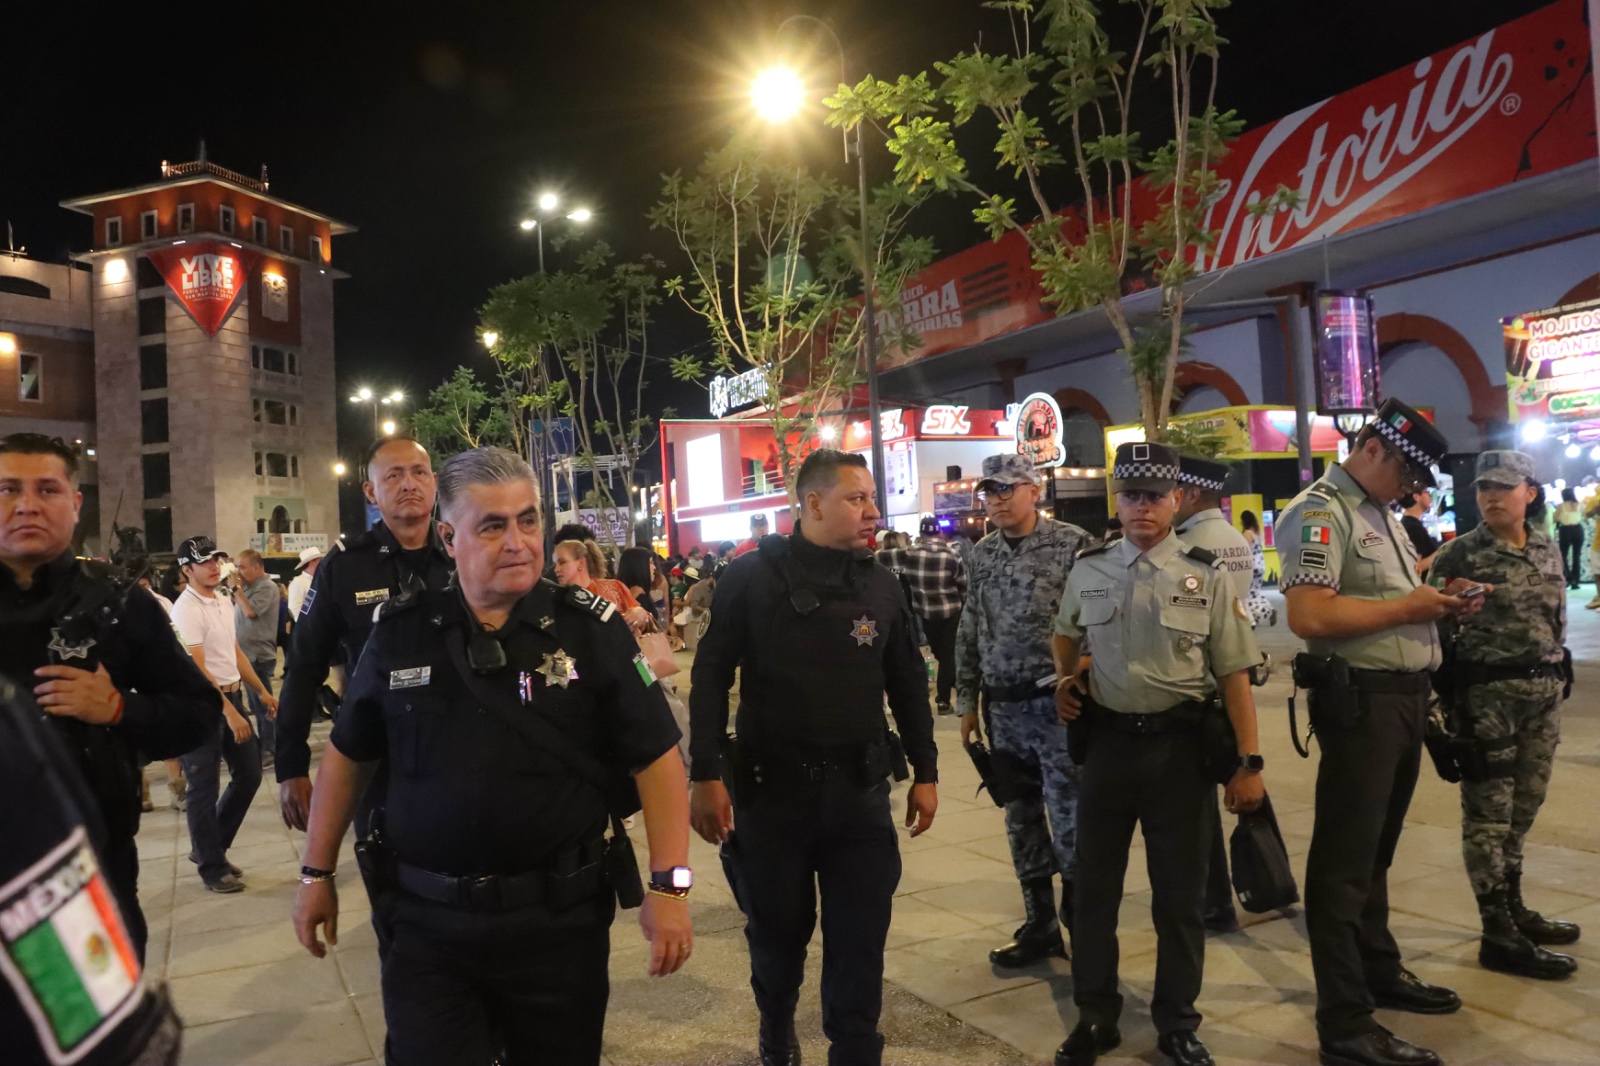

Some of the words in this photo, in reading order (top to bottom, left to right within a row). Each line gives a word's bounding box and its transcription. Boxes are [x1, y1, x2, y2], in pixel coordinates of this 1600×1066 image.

[1194, 28, 1513, 272] Victoria
[180, 254, 233, 275] VIVE
[182, 270, 233, 290] LIBRE
[902, 284, 924, 300] XICO
[1531, 311, 1600, 337] MOJITOS
[578, 512, 630, 525] POLCIA
[1213, 546, 1250, 559] UARDIA
[1226, 560, 1253, 572] IONAL
